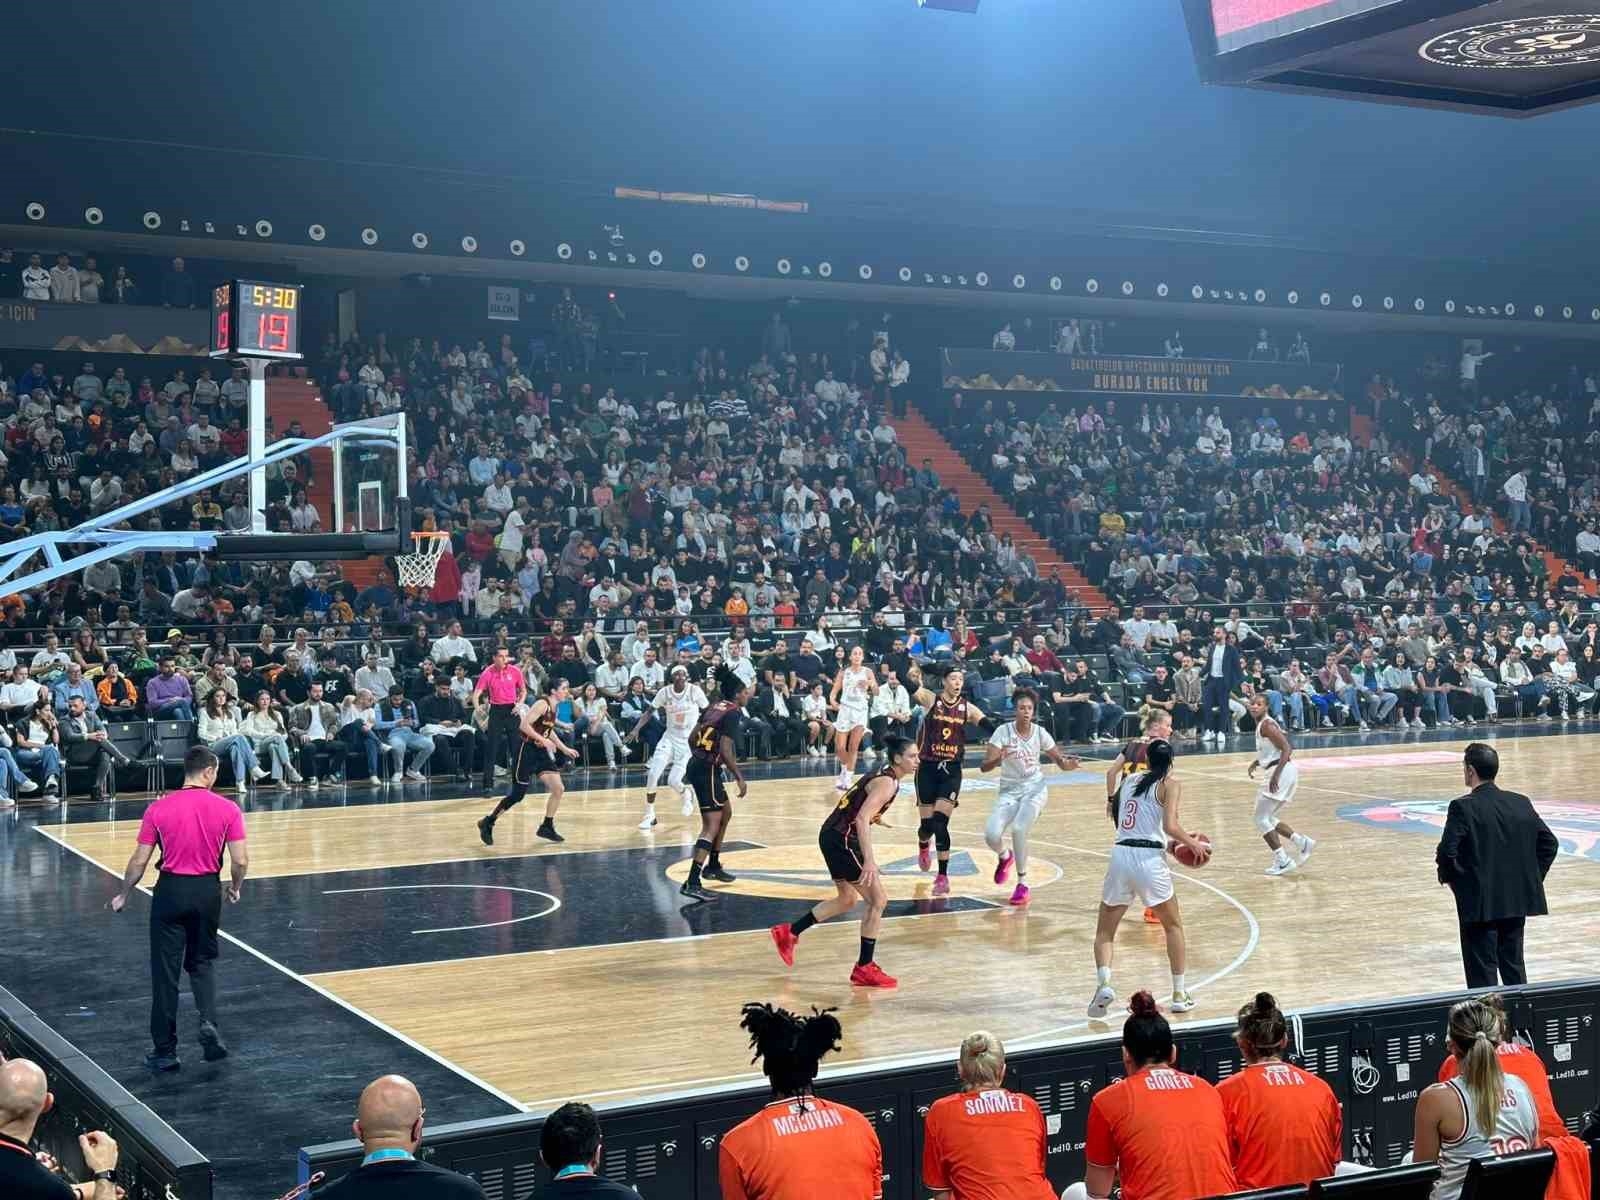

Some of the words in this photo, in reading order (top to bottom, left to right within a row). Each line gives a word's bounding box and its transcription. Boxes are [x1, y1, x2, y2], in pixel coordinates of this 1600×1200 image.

[253, 285, 296, 309] 5:30
[258, 312, 289, 351] 19
[942, 727, 952, 740] 9
[1122, 799, 1138, 831] 3
[1261, 1071, 1305, 1086] YAYA
